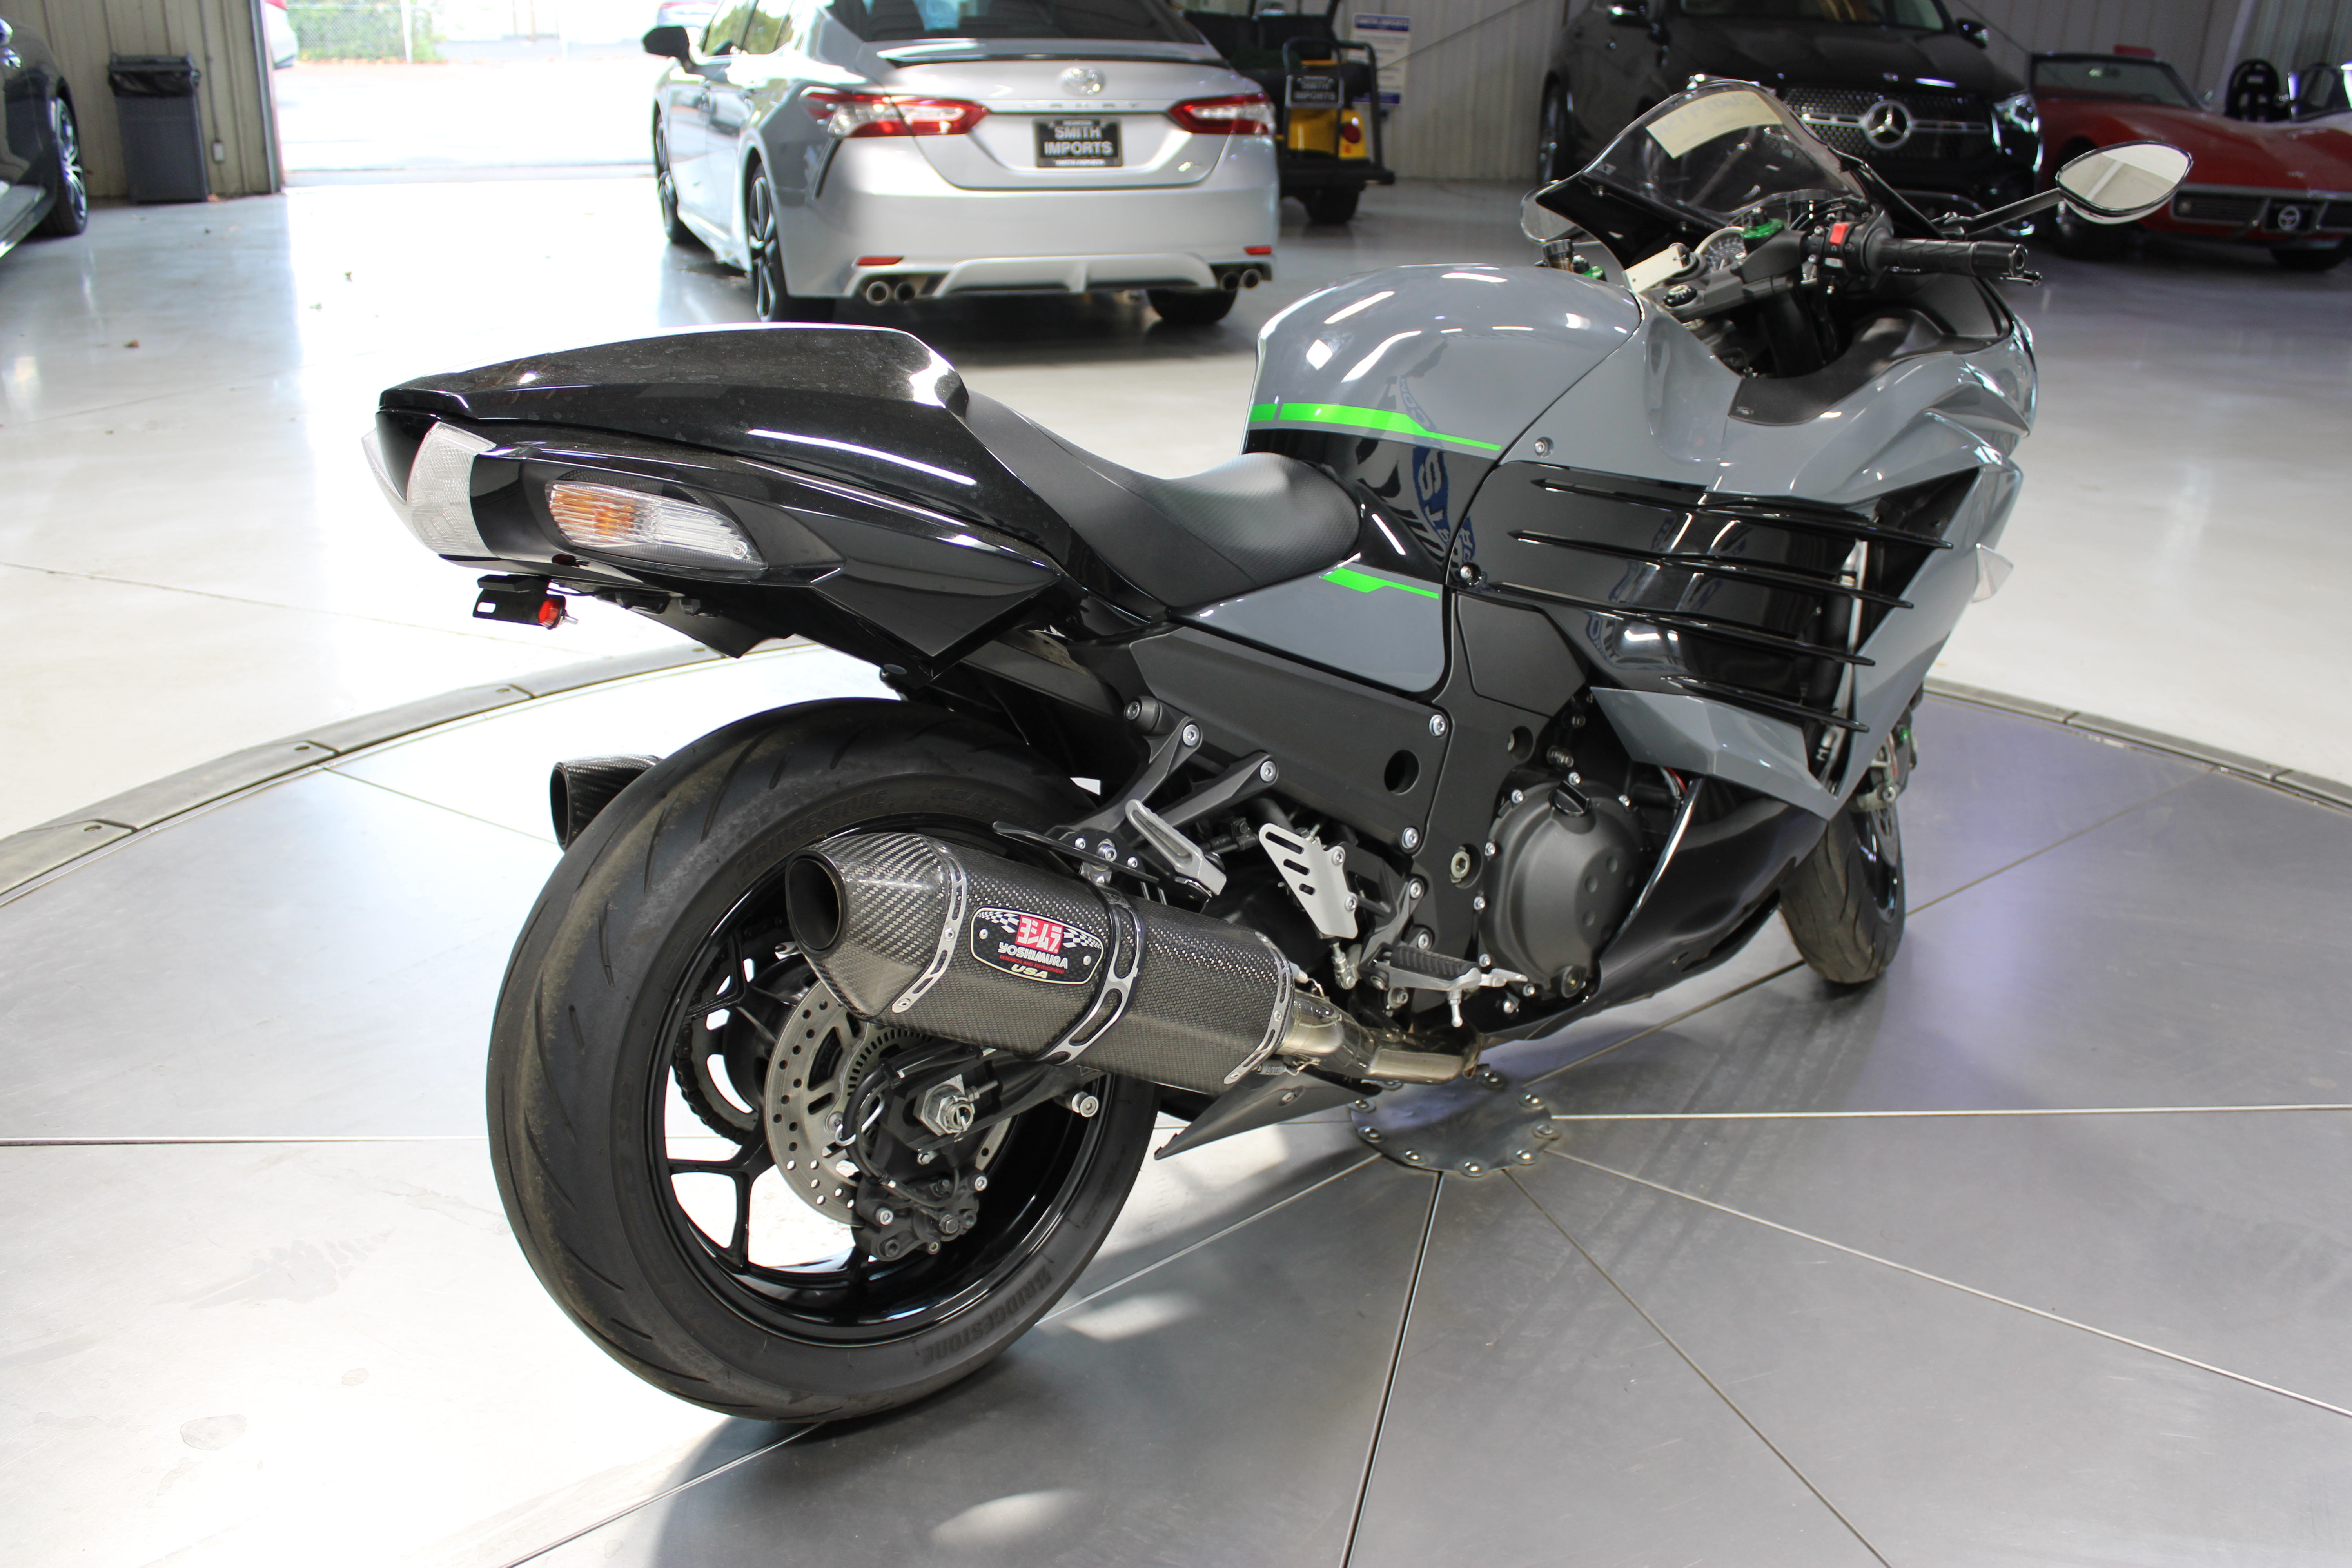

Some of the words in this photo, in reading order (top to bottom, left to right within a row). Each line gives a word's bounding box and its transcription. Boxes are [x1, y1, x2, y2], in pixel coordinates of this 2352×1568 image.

[1054, 127, 1102, 140] SMITH
[1044, 141, 1114, 156] IMPORTS
[737, 789, 887, 880] BRIDGESTONE
[998, 942, 1068, 969] YOSHIMURA
[999, 955, 1022, 964] RESEARCH
[1034, 964, 1065, 974] DEVELOPMENT
[1011, 964, 1048, 979] USA
[923, 1265, 1051, 1364] BRIDGESTONE
